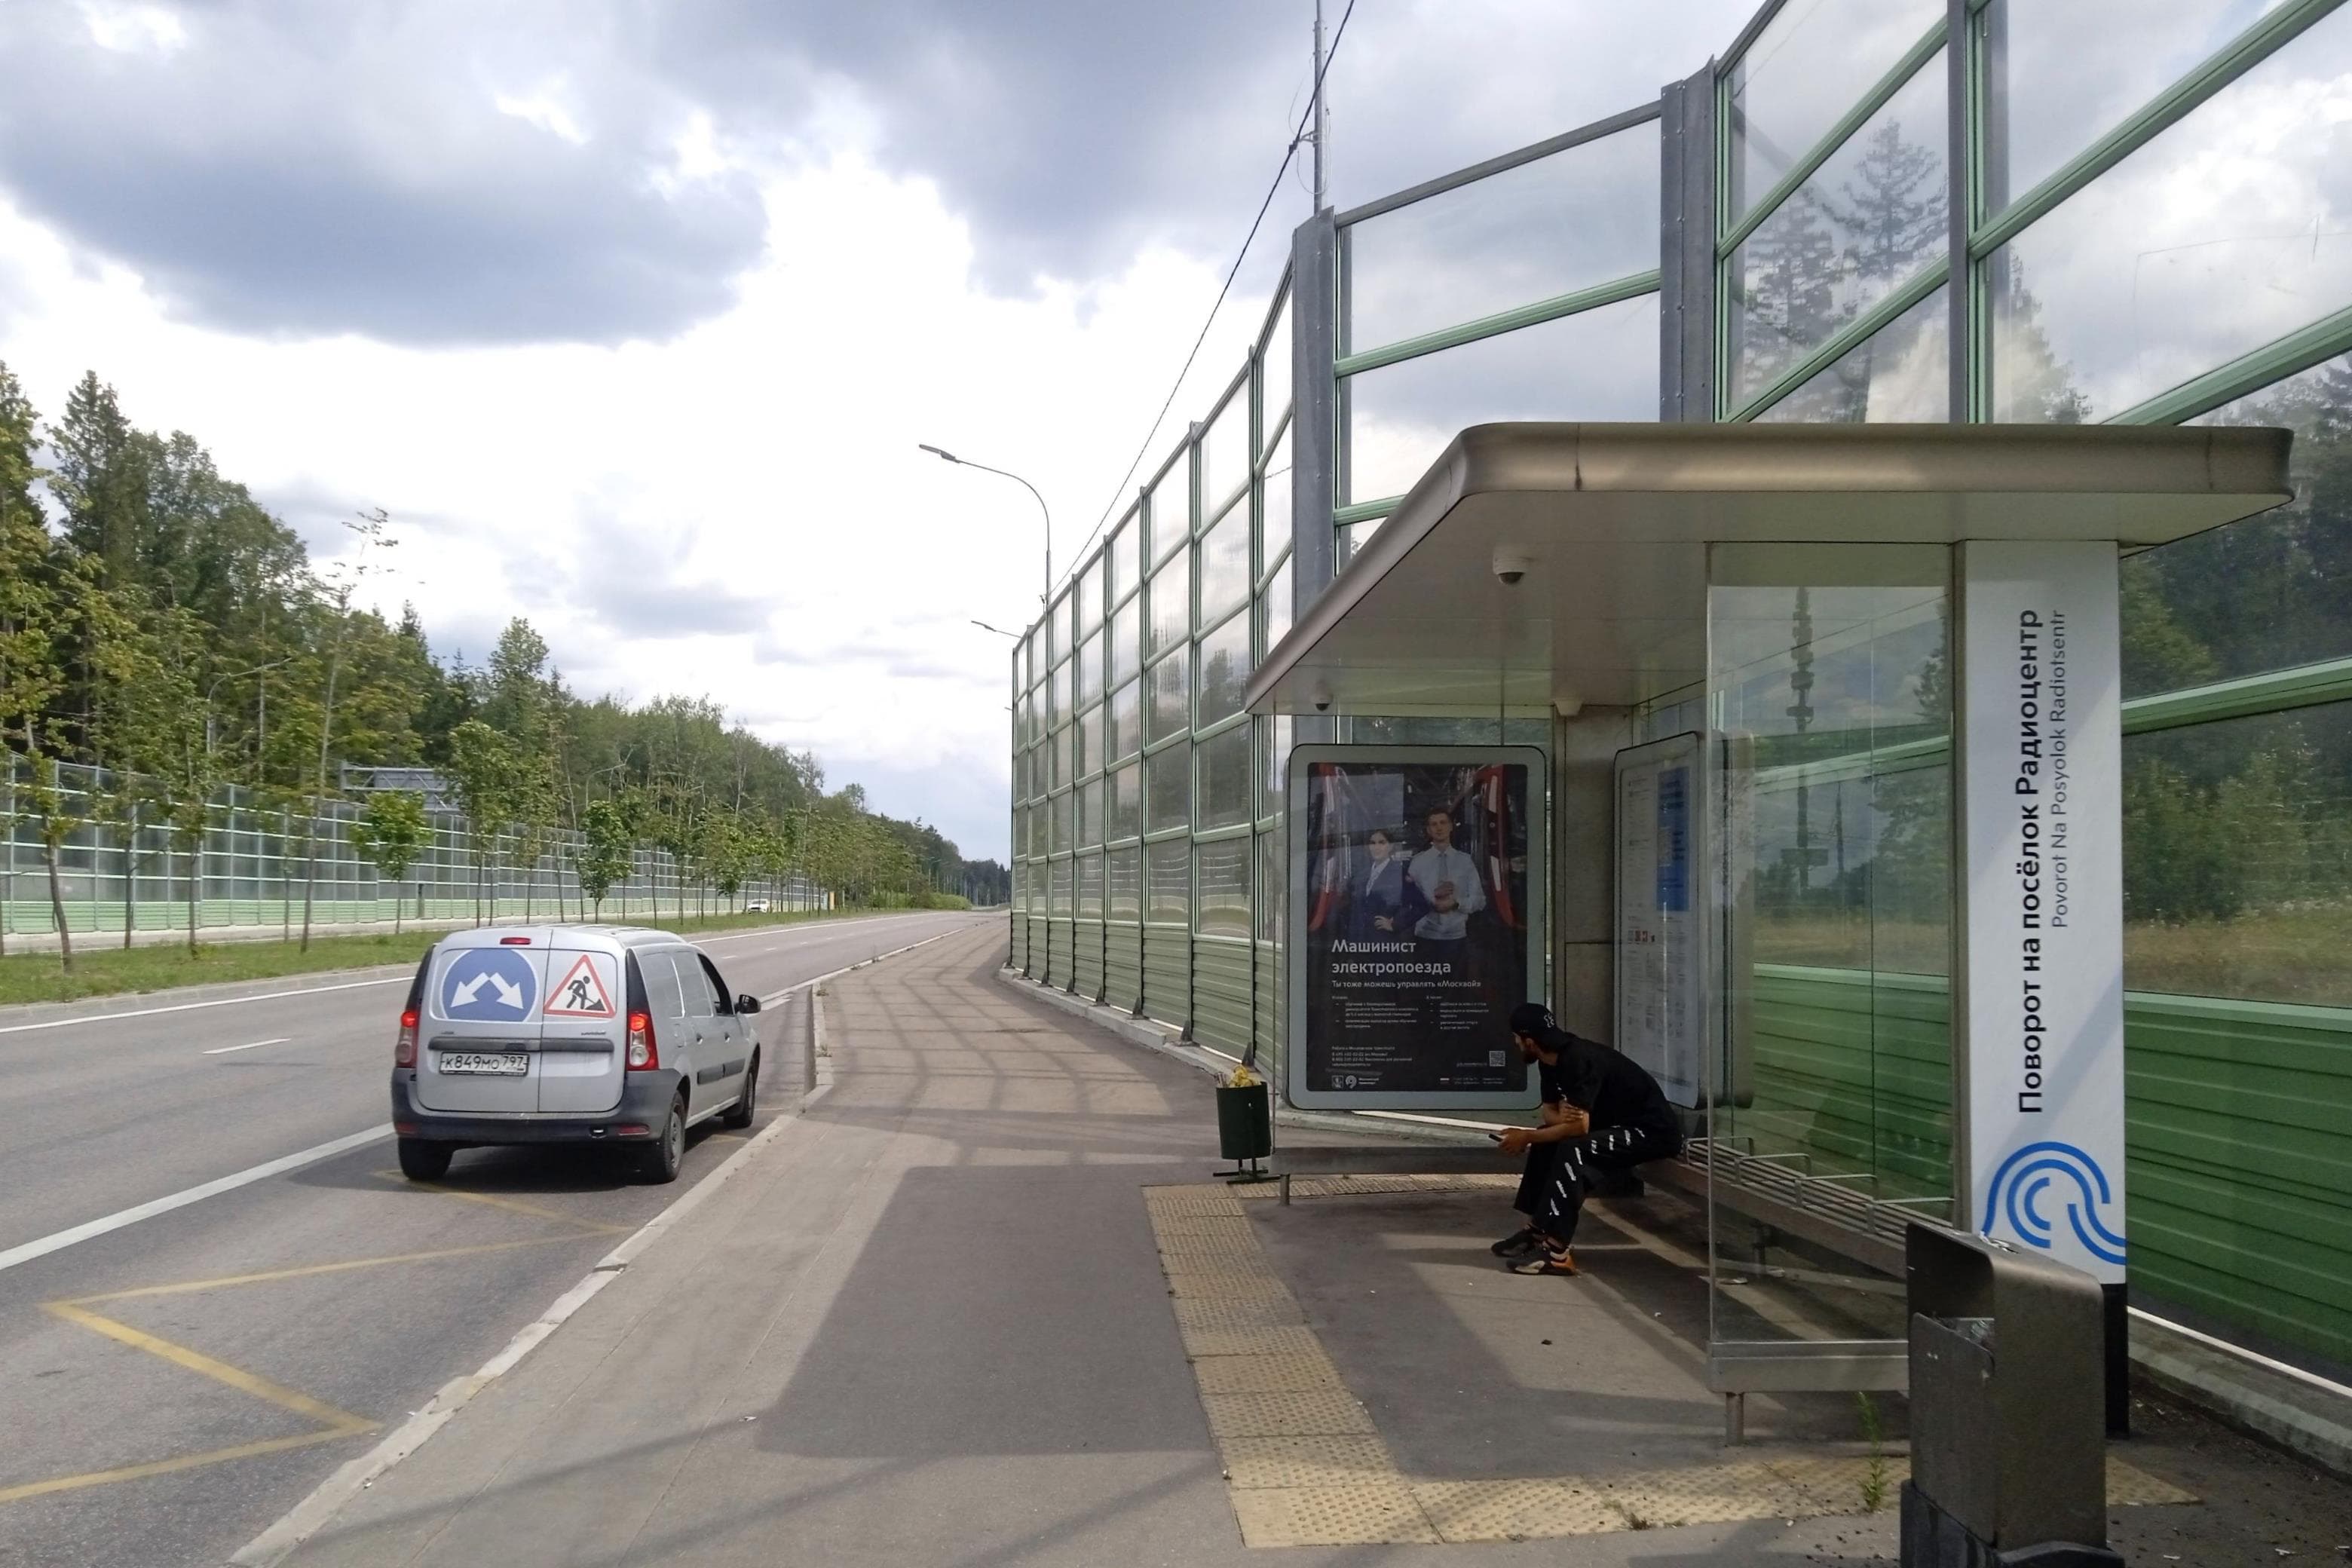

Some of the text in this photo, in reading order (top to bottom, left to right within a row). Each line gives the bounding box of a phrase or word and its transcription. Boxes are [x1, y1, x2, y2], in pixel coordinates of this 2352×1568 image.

[2047, 609, 2071, 928] Povorot Na Posyolok Radiotsentr
[2014, 610, 2047, 1113] Поворот на посёлок Радиоцентр
[1331, 939, 1416, 953] Машинист
[1331, 962, 1452, 976] электропоезда
[1397, 981, 1436, 989] управлять
